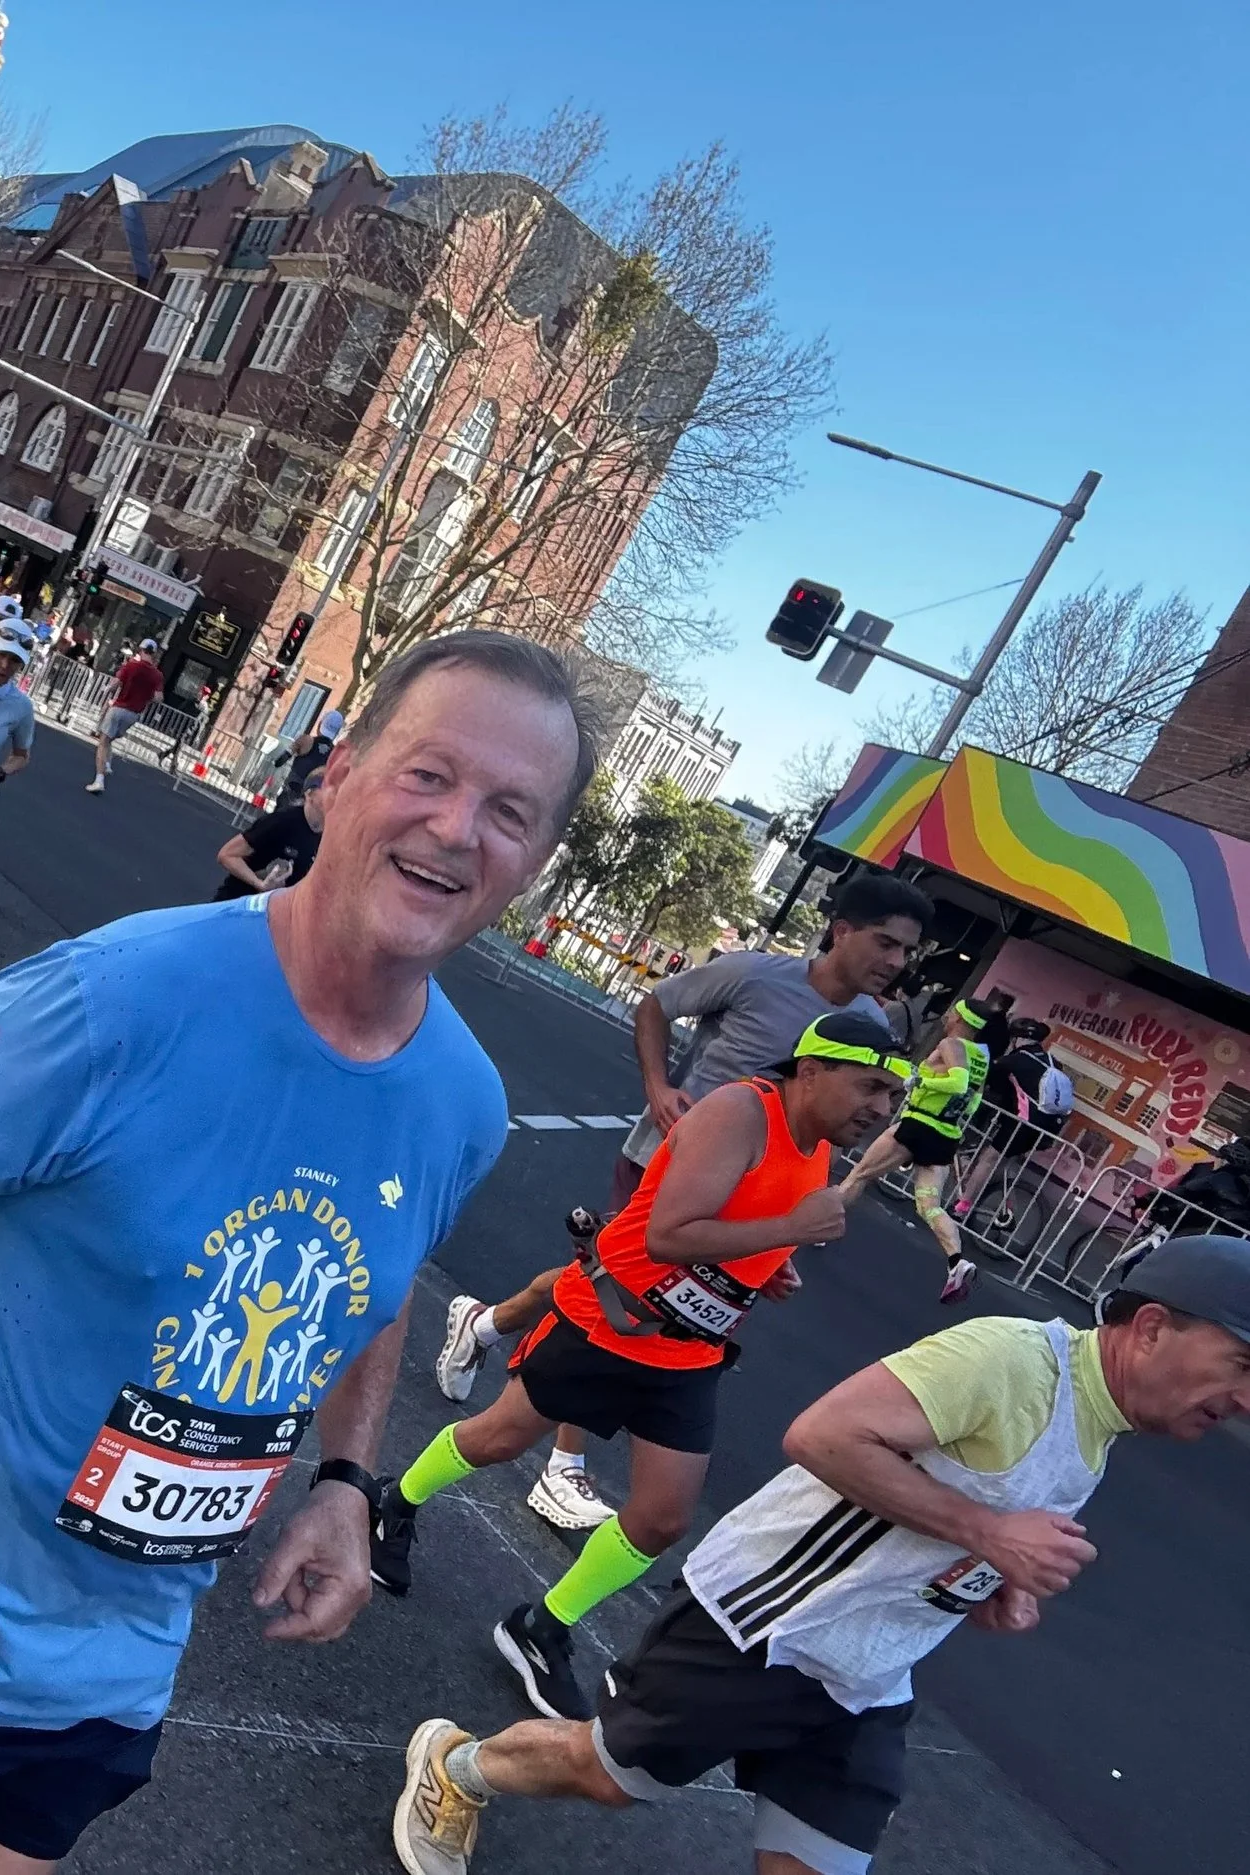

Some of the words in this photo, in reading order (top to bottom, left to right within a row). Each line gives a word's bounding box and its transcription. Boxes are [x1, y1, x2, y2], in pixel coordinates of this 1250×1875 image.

[1049, 1003, 1126, 1042] UNIVERSAL
[1123, 1013, 1195, 1066] RUBY
[1162, 1058, 1209, 1135] REDS
[294, 1166, 340, 1187] STANLEY
[203, 1187, 312, 1257] ORGAN
[312, 1196, 371, 1317] DONOR
[676, 1287, 732, 1328] 34521
[152, 1316, 181, 1390] CAN
[129, 1399, 182, 1442] tcs
[189, 1418, 216, 1433] TATA
[101, 1437, 125, 1451] START
[178, 1438, 219, 1454] SERVICES
[183, 1429, 243, 1445] CONSULTANCY
[96, 1444, 122, 1459] GROUP
[265, 1441, 292, 1454] TATA
[85, 1467, 104, 1487] 2
[73, 1491, 96, 1507] 2025
[122, 1472, 254, 1523] 30783
[143, 1540, 165, 1556] tcs
